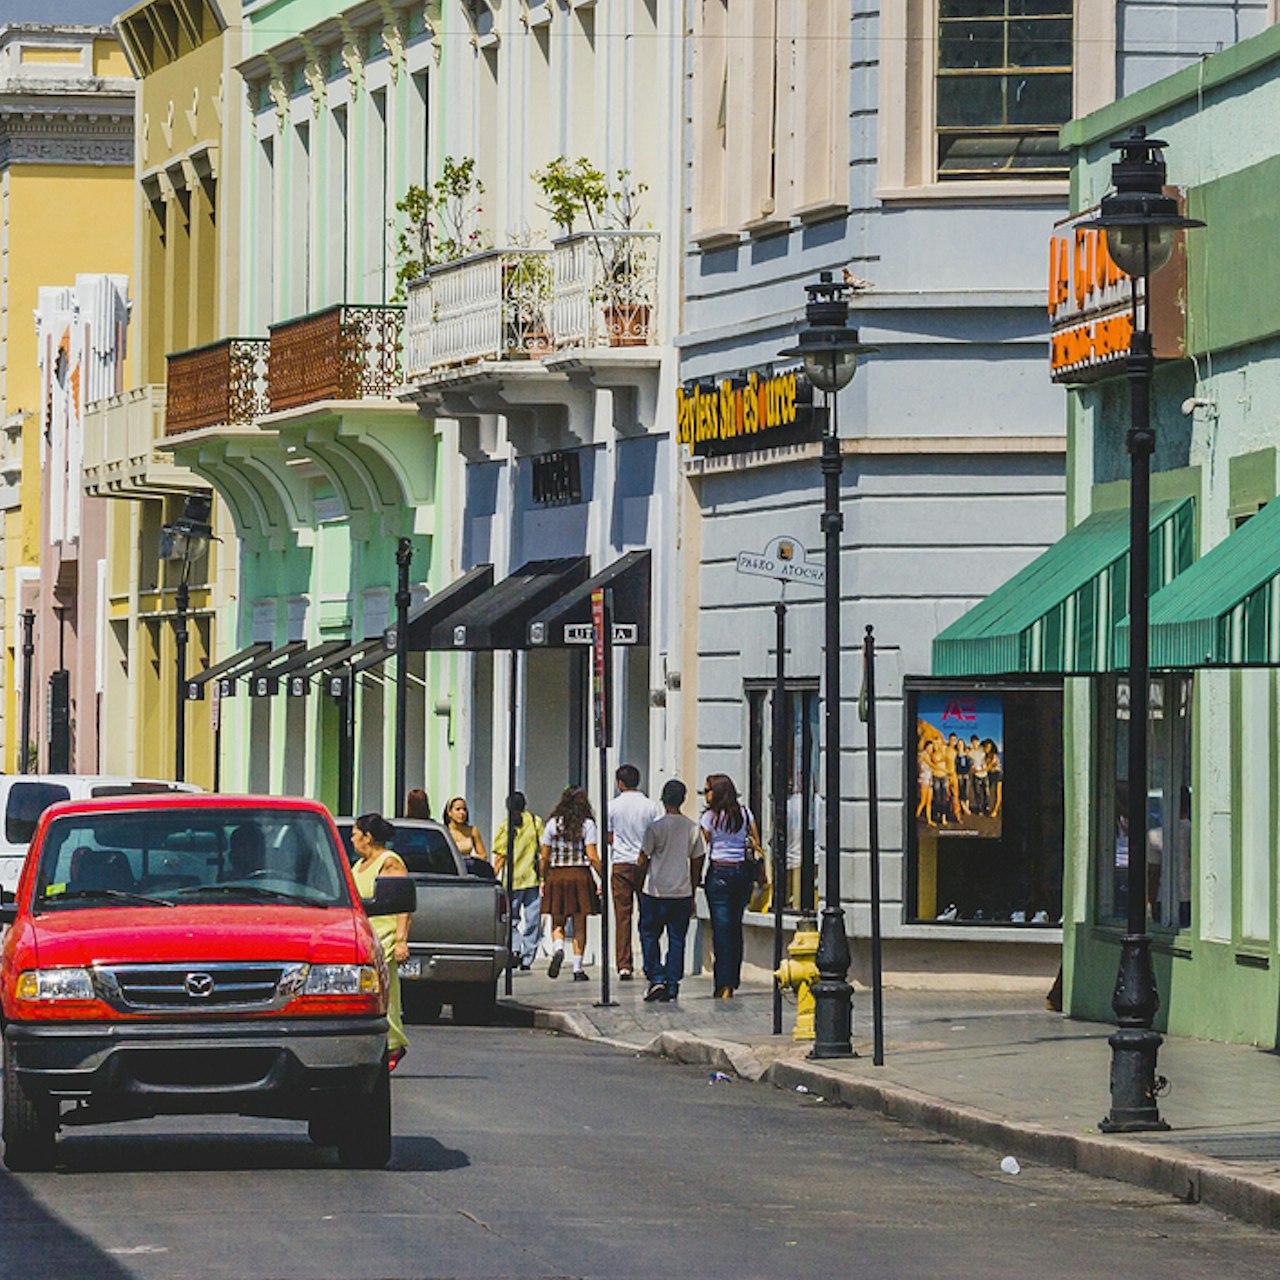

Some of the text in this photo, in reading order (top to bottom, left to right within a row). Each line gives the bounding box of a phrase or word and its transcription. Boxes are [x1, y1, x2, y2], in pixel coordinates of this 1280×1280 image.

[676, 371, 797, 456] Payless ShoeSource
[740, 557, 825, 581] PASEO ATOCHA
